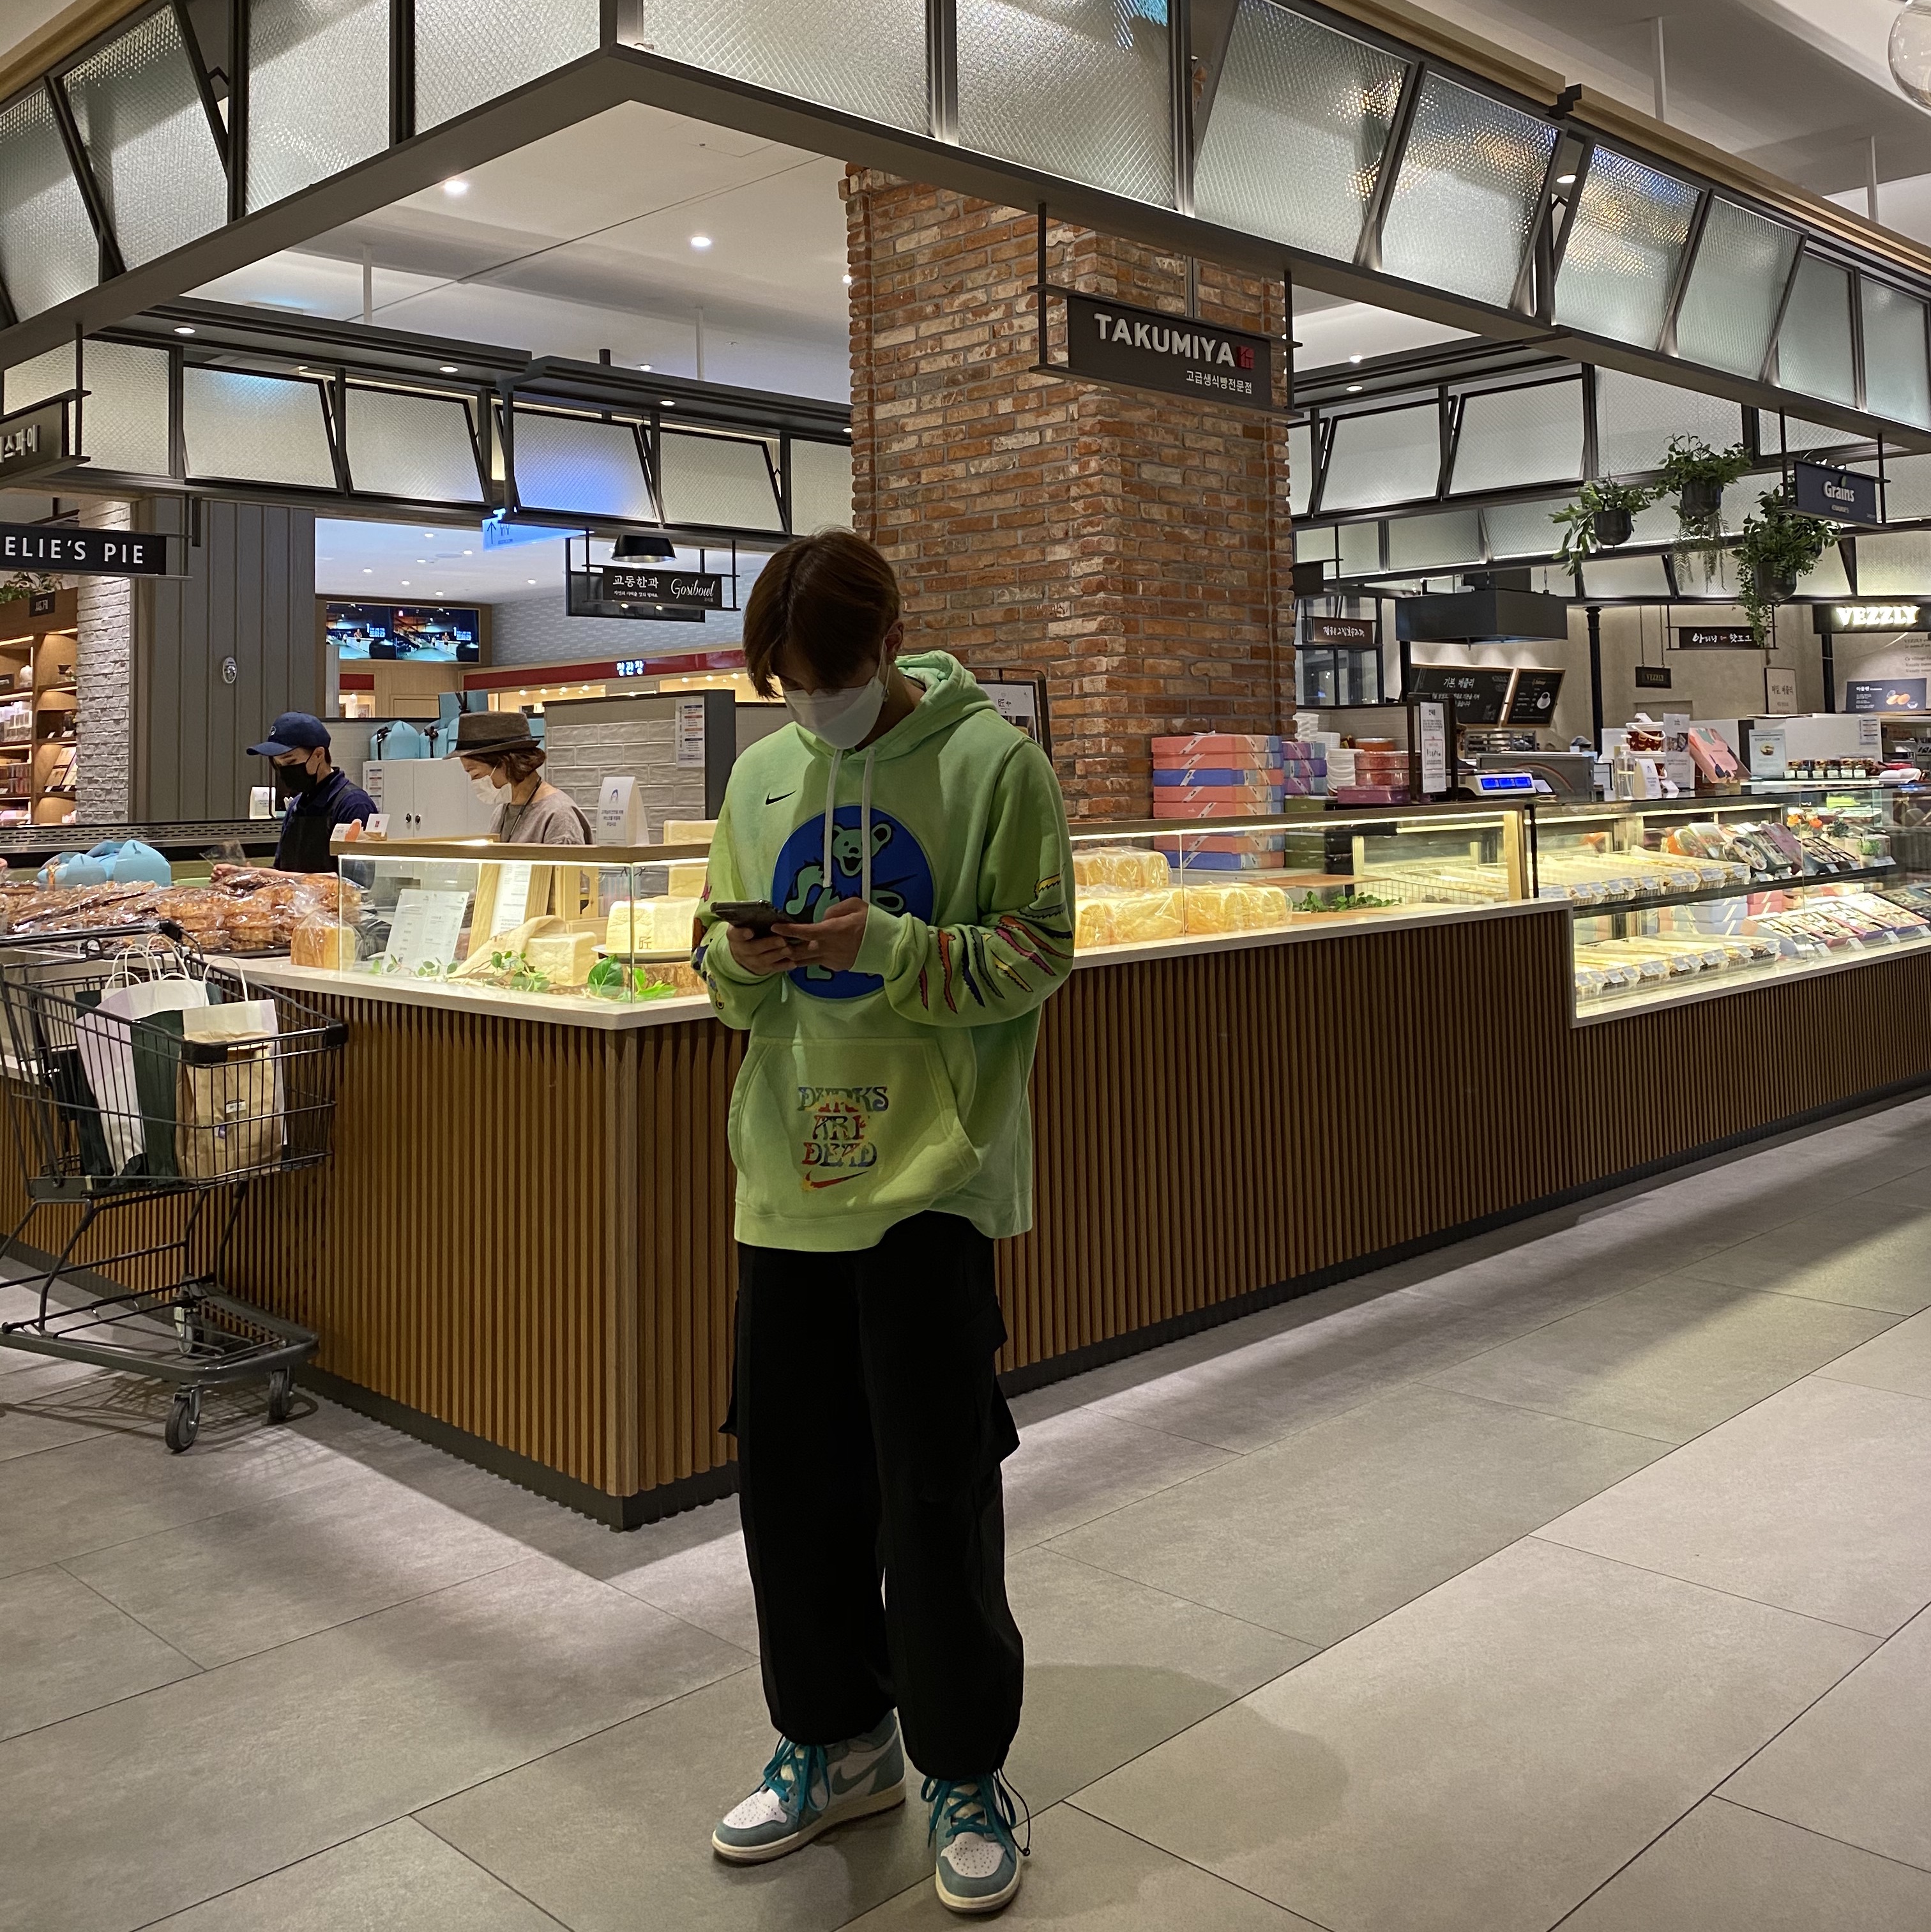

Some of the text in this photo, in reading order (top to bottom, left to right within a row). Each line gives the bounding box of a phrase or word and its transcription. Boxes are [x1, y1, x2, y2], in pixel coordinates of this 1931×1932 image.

[1094, 312, 1236, 367] TAKUMIYA
[1186, 370, 1252, 395] 고급생식빵전문점
[1823, 480, 1855, 503] Grains
[5, 536, 144, 564] ELIE'S PIE
[612, 575, 659, 589] 교동한과
[670, 577, 716, 599] Gosibowl
[1836, 605, 1921, 626] VEZZLY
[1729, 632, 1752, 643] 핫도그
[616, 660, 644, 676] 정관장
[812, 1114, 867, 1141] ARE
[801, 1141, 878, 1168] DEAD
